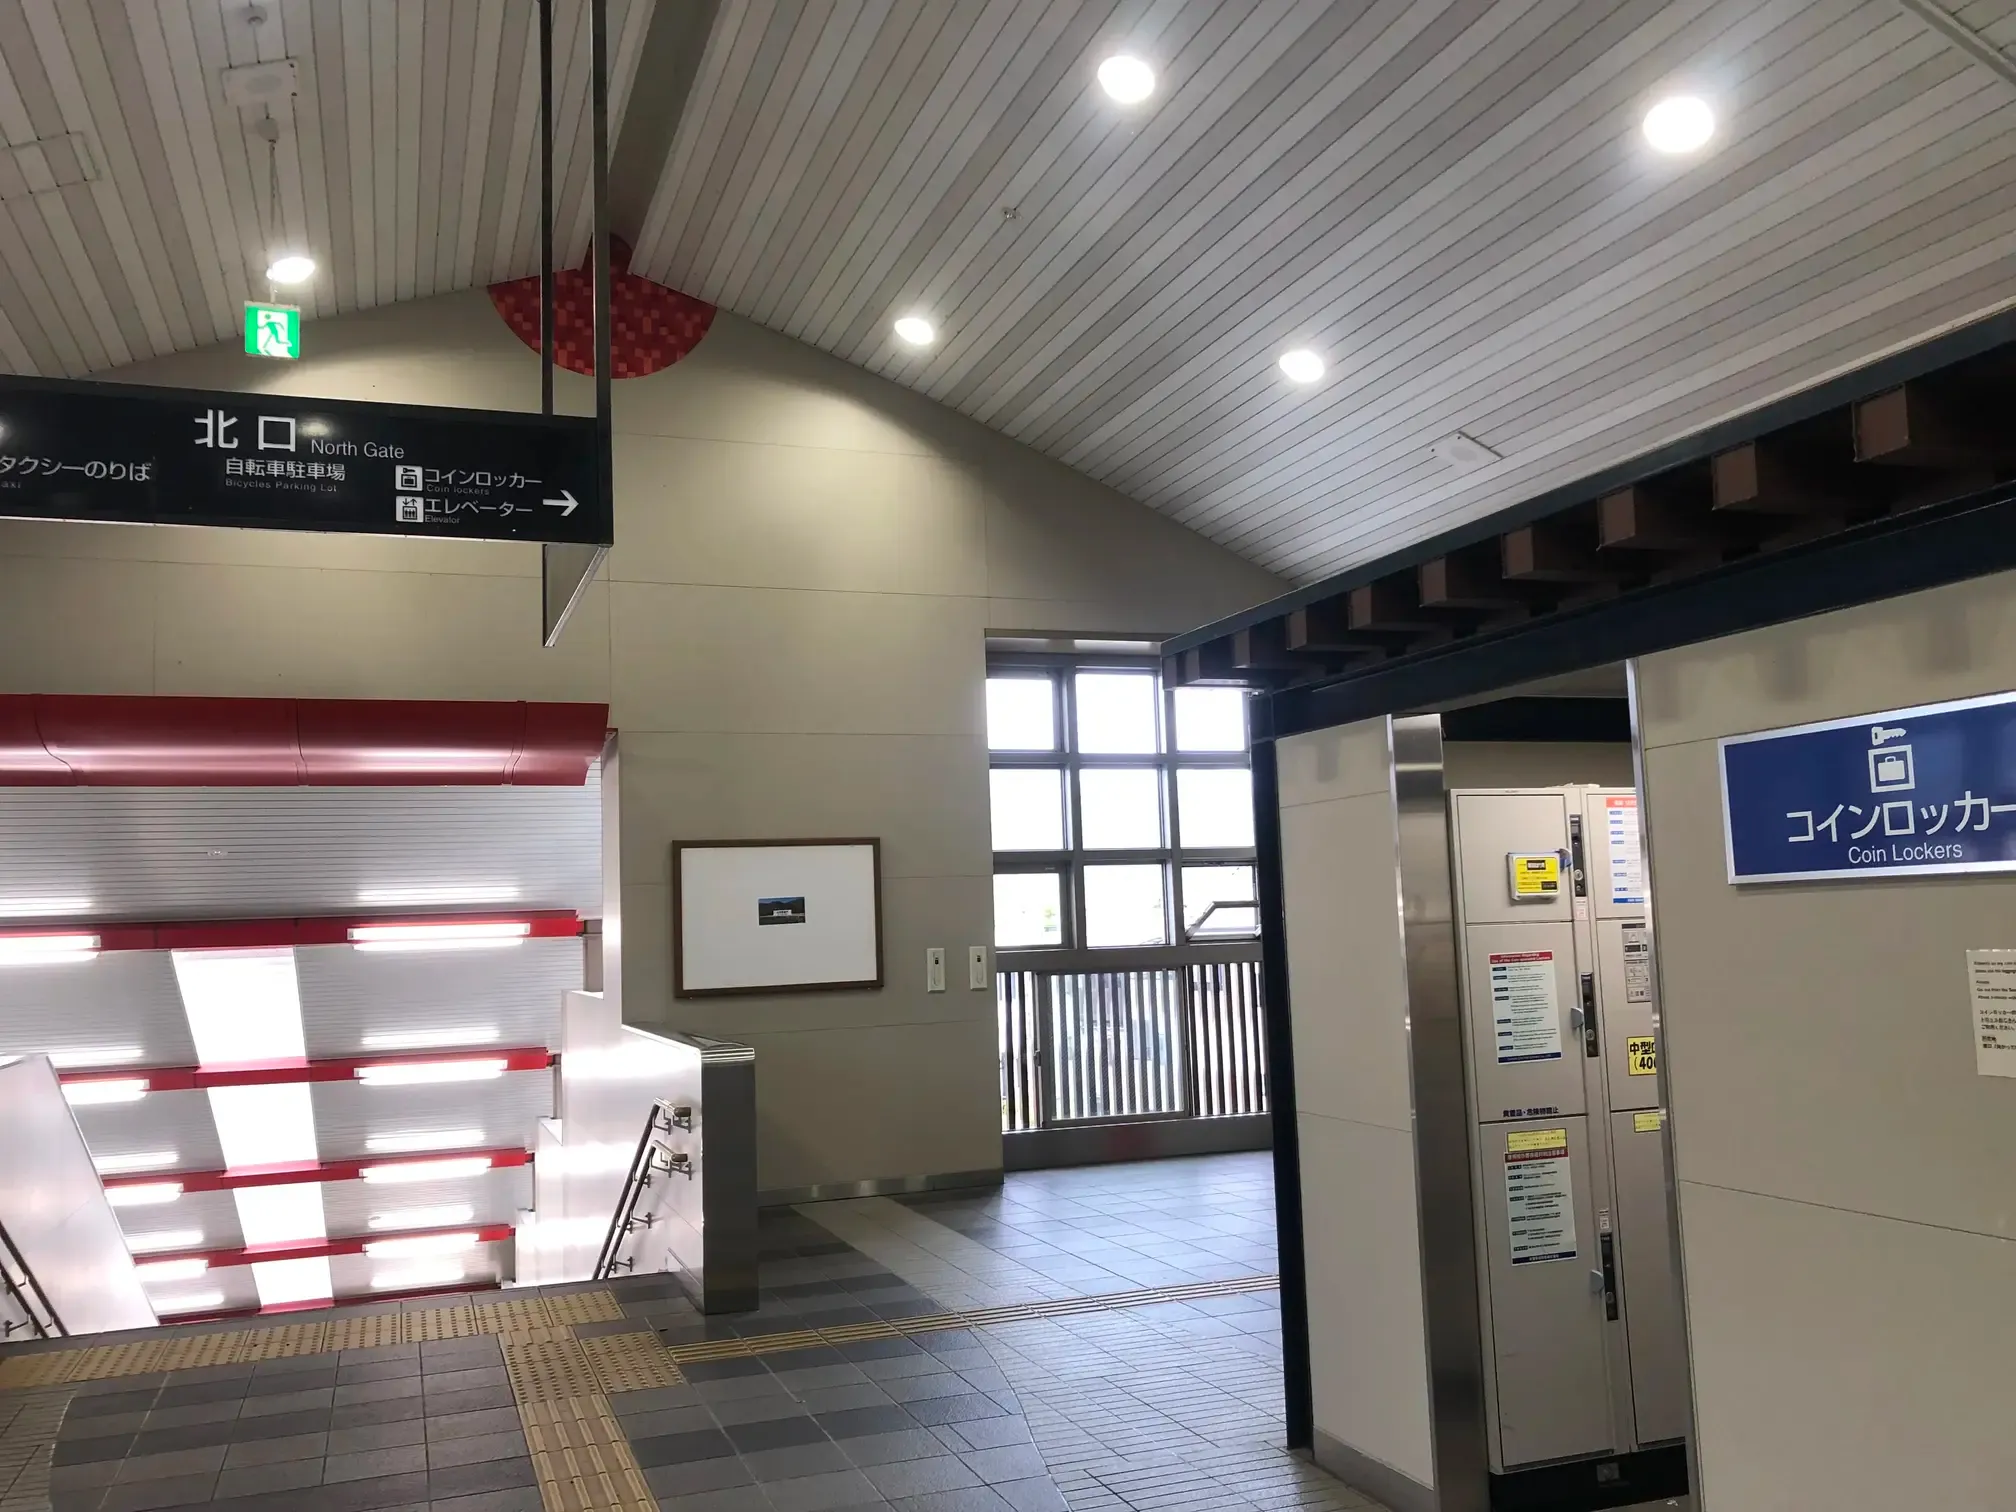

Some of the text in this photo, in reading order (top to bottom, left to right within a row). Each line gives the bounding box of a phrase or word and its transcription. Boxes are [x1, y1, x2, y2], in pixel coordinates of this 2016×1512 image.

[194, 408, 296, 452] 北口
[310, 438, 405, 460] North Gate
[0, 455, 153, 482] タクシーのりば
[225, 456, 346, 482] 自転車駐車場
[424, 468, 543, 489] コインロッカー
[1, 481, 22, 489] axi
[225, 478, 337, 493] Bicycles Parking Lot
[426, 483, 450, 493] Coin
[424, 498, 533, 518] エレベーター
[424, 514, 461, 524] Elevator
[1785, 790, 2016, 843] コインロッカー
[1847, 841, 1964, 865] Coin Lockers
[1634, 1056, 1657, 1071] (40
